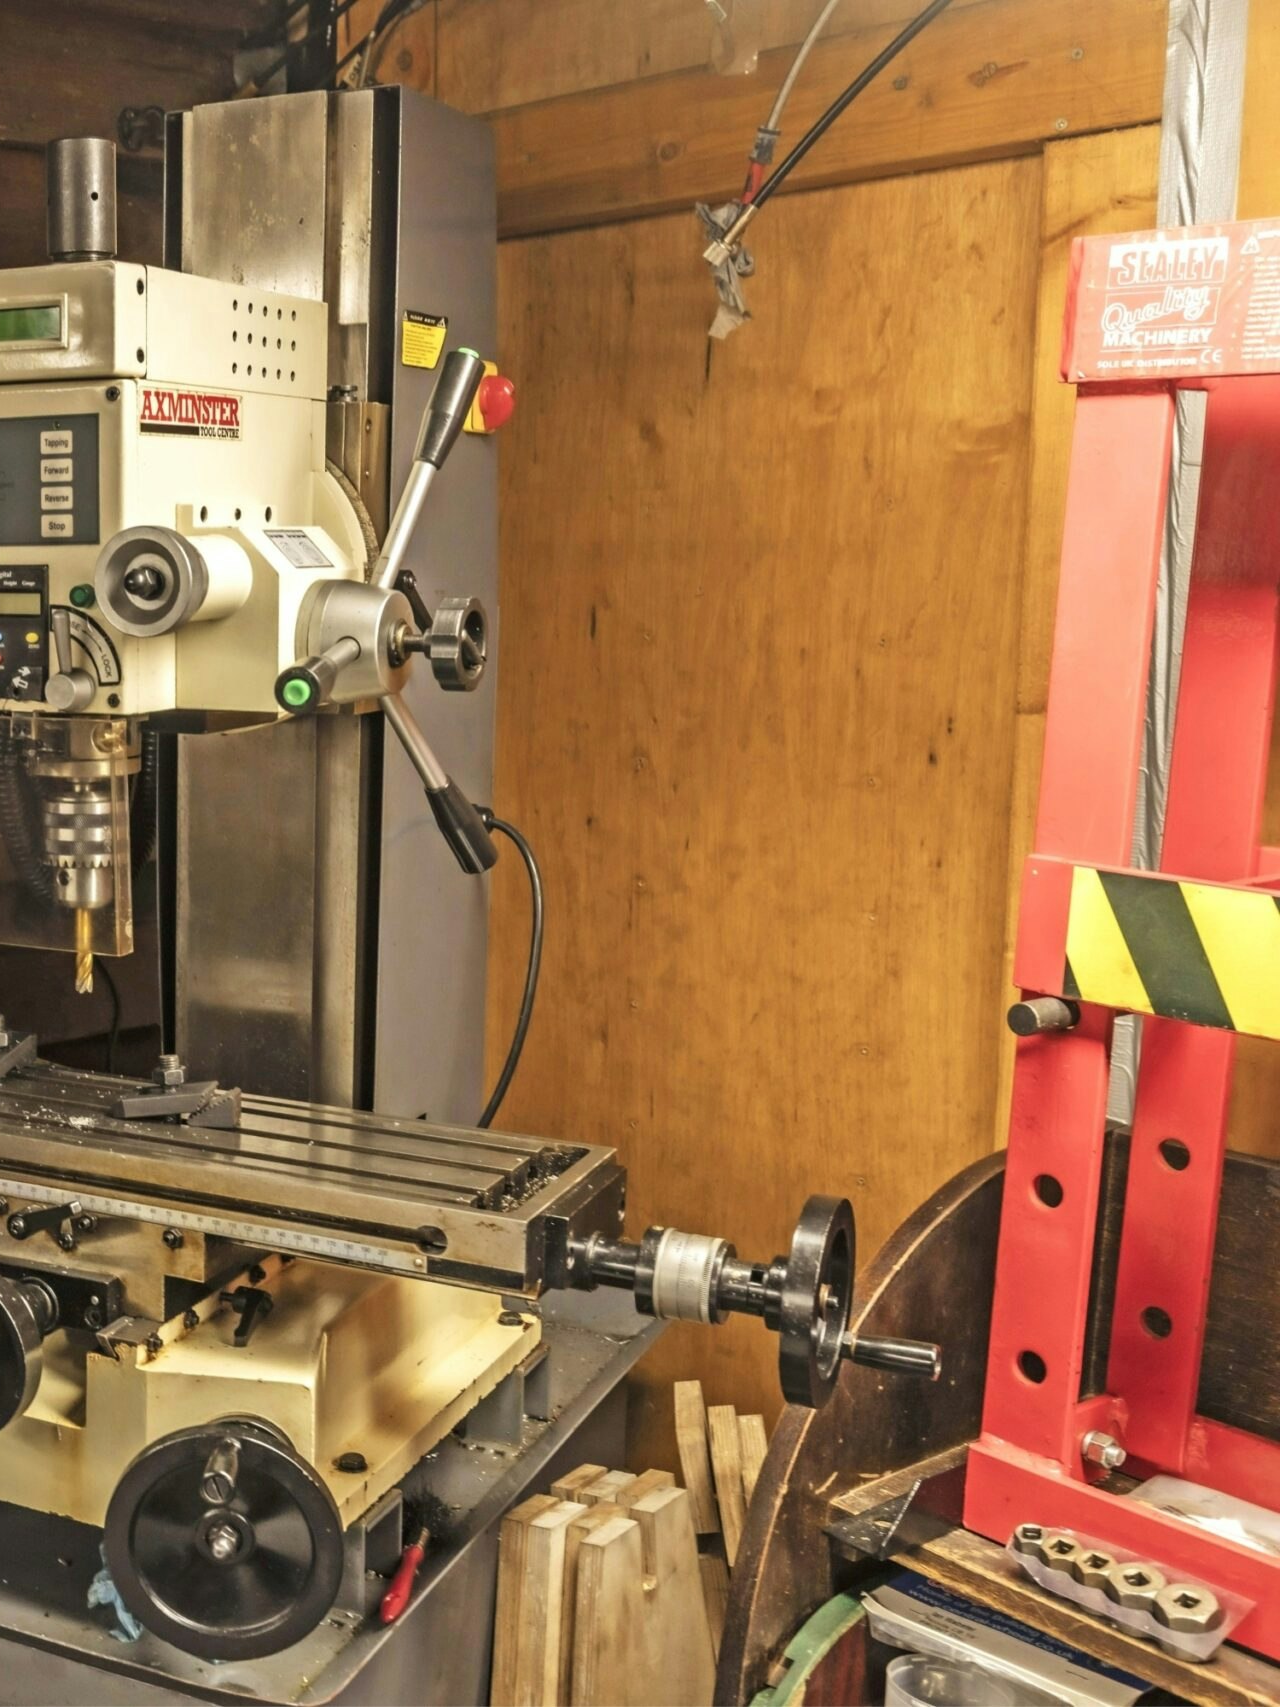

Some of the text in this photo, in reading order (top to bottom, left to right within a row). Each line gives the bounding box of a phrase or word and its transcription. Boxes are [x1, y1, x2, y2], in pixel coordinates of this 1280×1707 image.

[1118, 246, 1221, 285] SEALEY
[1101, 286, 1210, 333] Quality
[1103, 328, 1213, 347] MACHINERY
[140, 391, 240, 427] AXMINSTER
[201, 427, 239, 438] TOOL CENTRE
[44, 438, 69, 448] Tapping
[44, 465, 69, 475] Forward
[44, 494, 69, 503] Reverse
[48, 521, 66, 532] Stop
[101, 653, 113, 679] LOCK
